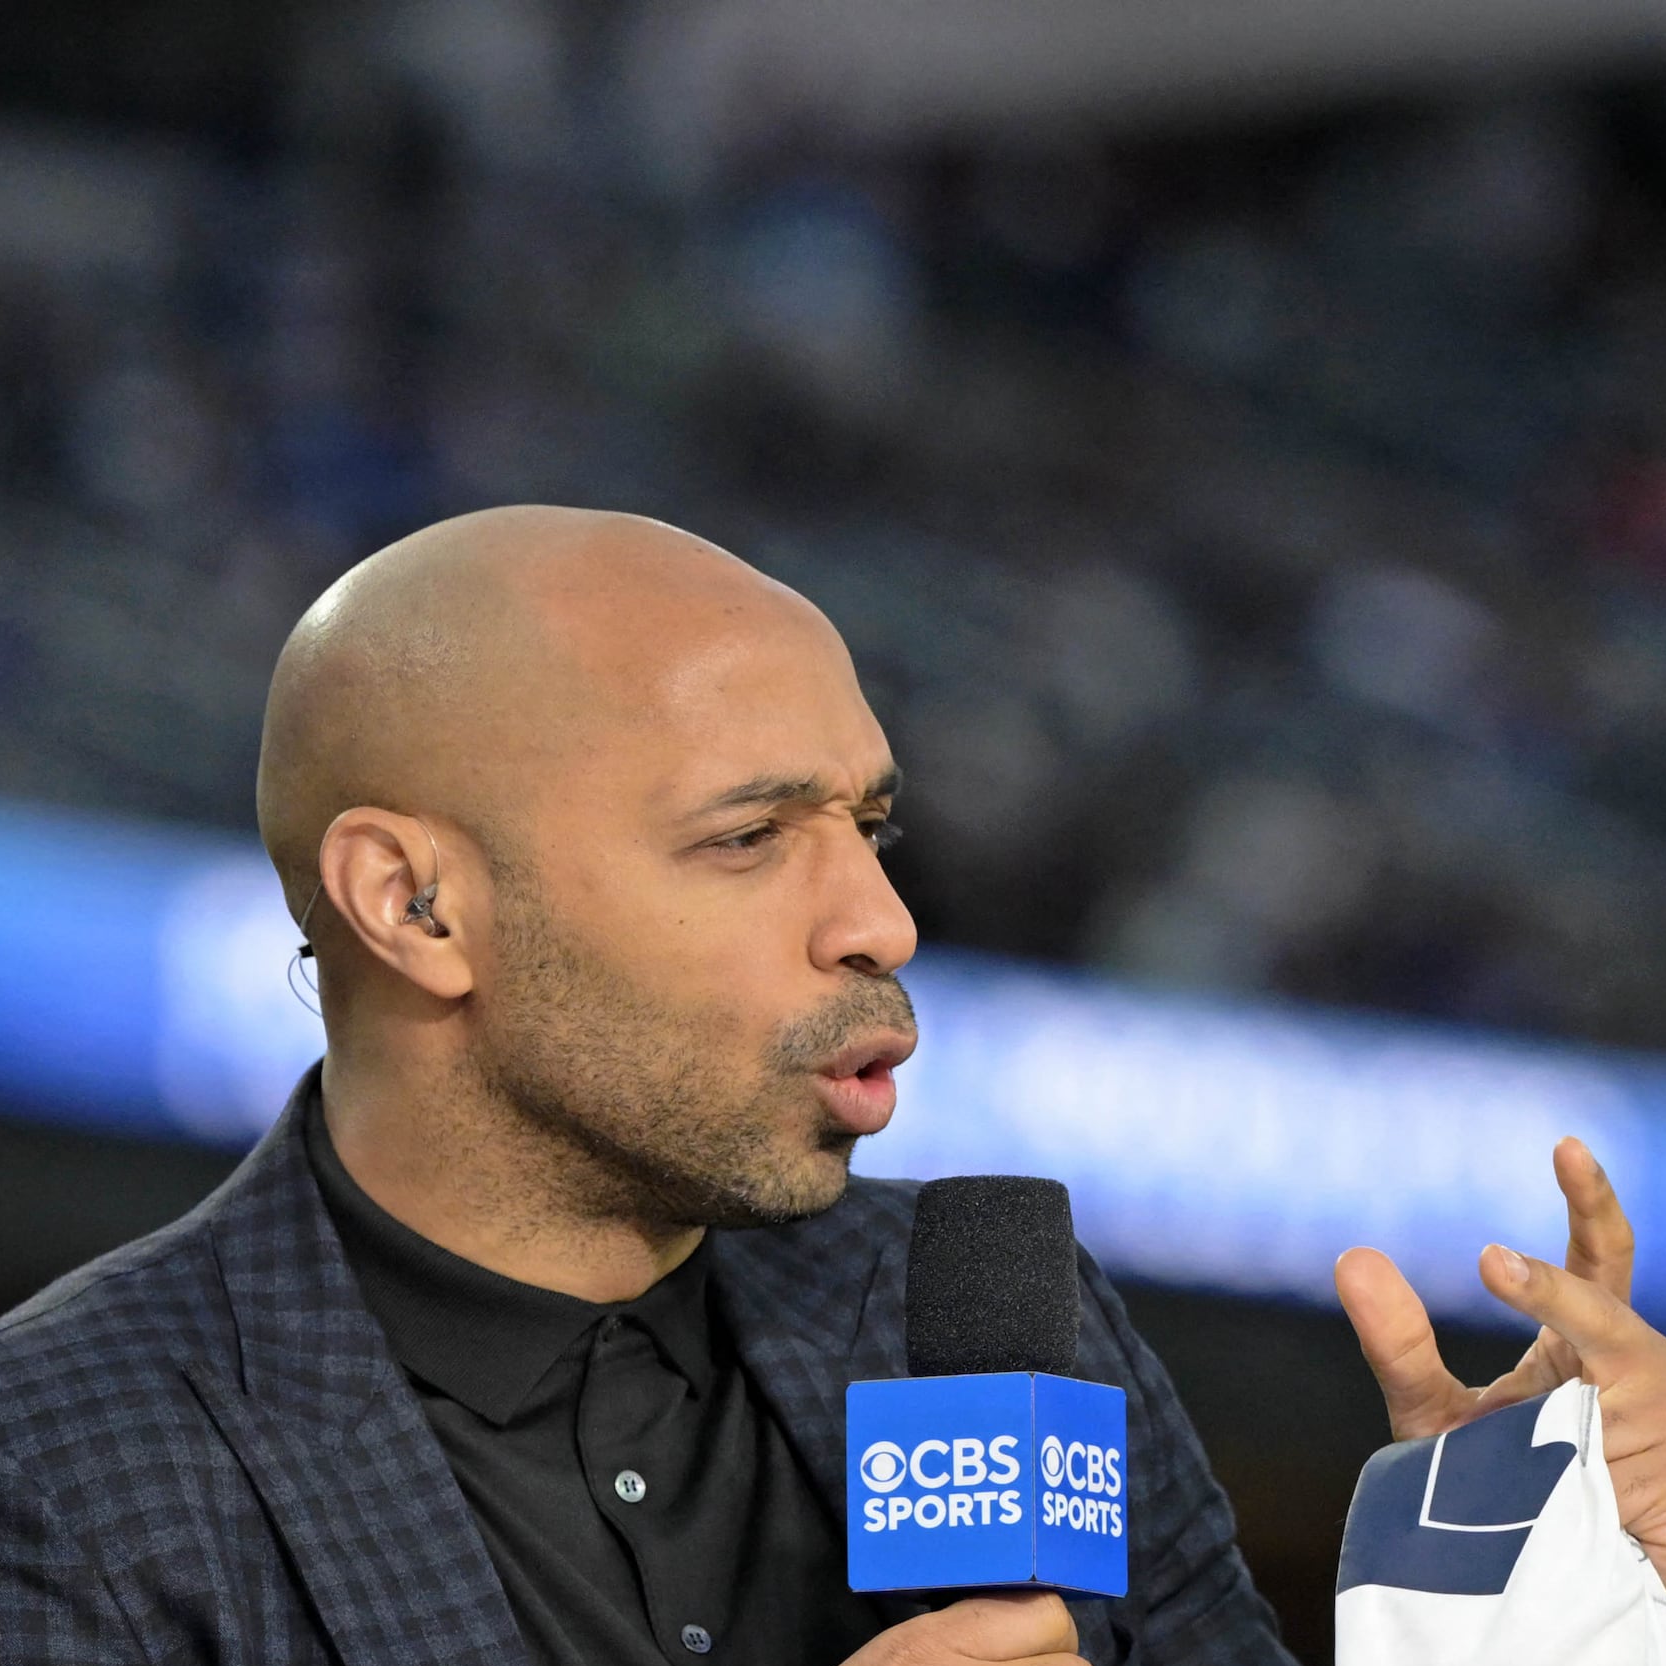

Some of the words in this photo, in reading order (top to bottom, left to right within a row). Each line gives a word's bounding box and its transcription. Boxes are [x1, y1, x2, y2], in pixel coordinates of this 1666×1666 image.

[909, 1435, 1021, 1489] CBS
[1064, 1441, 1122, 1497] CBS
[863, 1490, 1023, 1532] SPORTS
[1042, 1491, 1123, 1538] SPORTS
